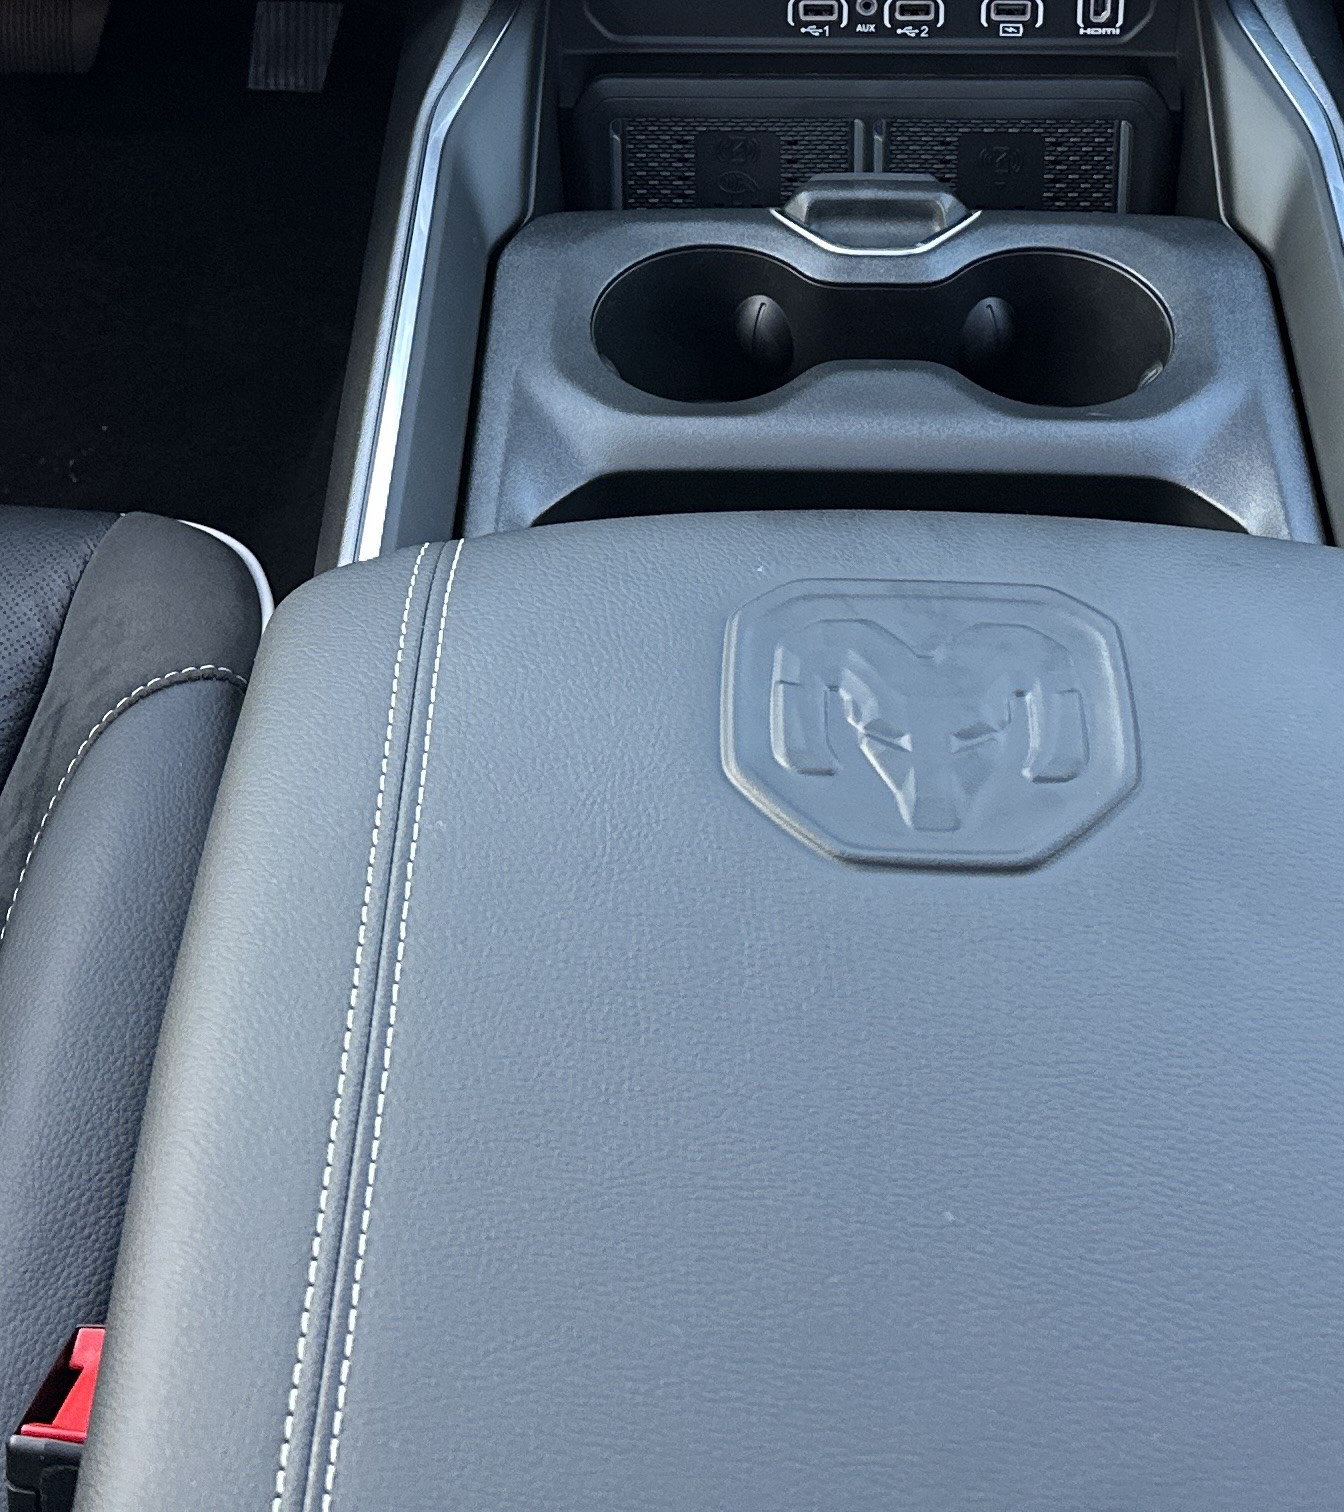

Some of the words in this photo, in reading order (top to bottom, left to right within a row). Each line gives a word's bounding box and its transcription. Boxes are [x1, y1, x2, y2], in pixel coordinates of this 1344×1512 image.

[824, 26, 829, 37] 1
[856, 24, 876, 33] AUX
[921, 26, 929, 37] 2
[1079, 27, 1120, 35] HDMI
